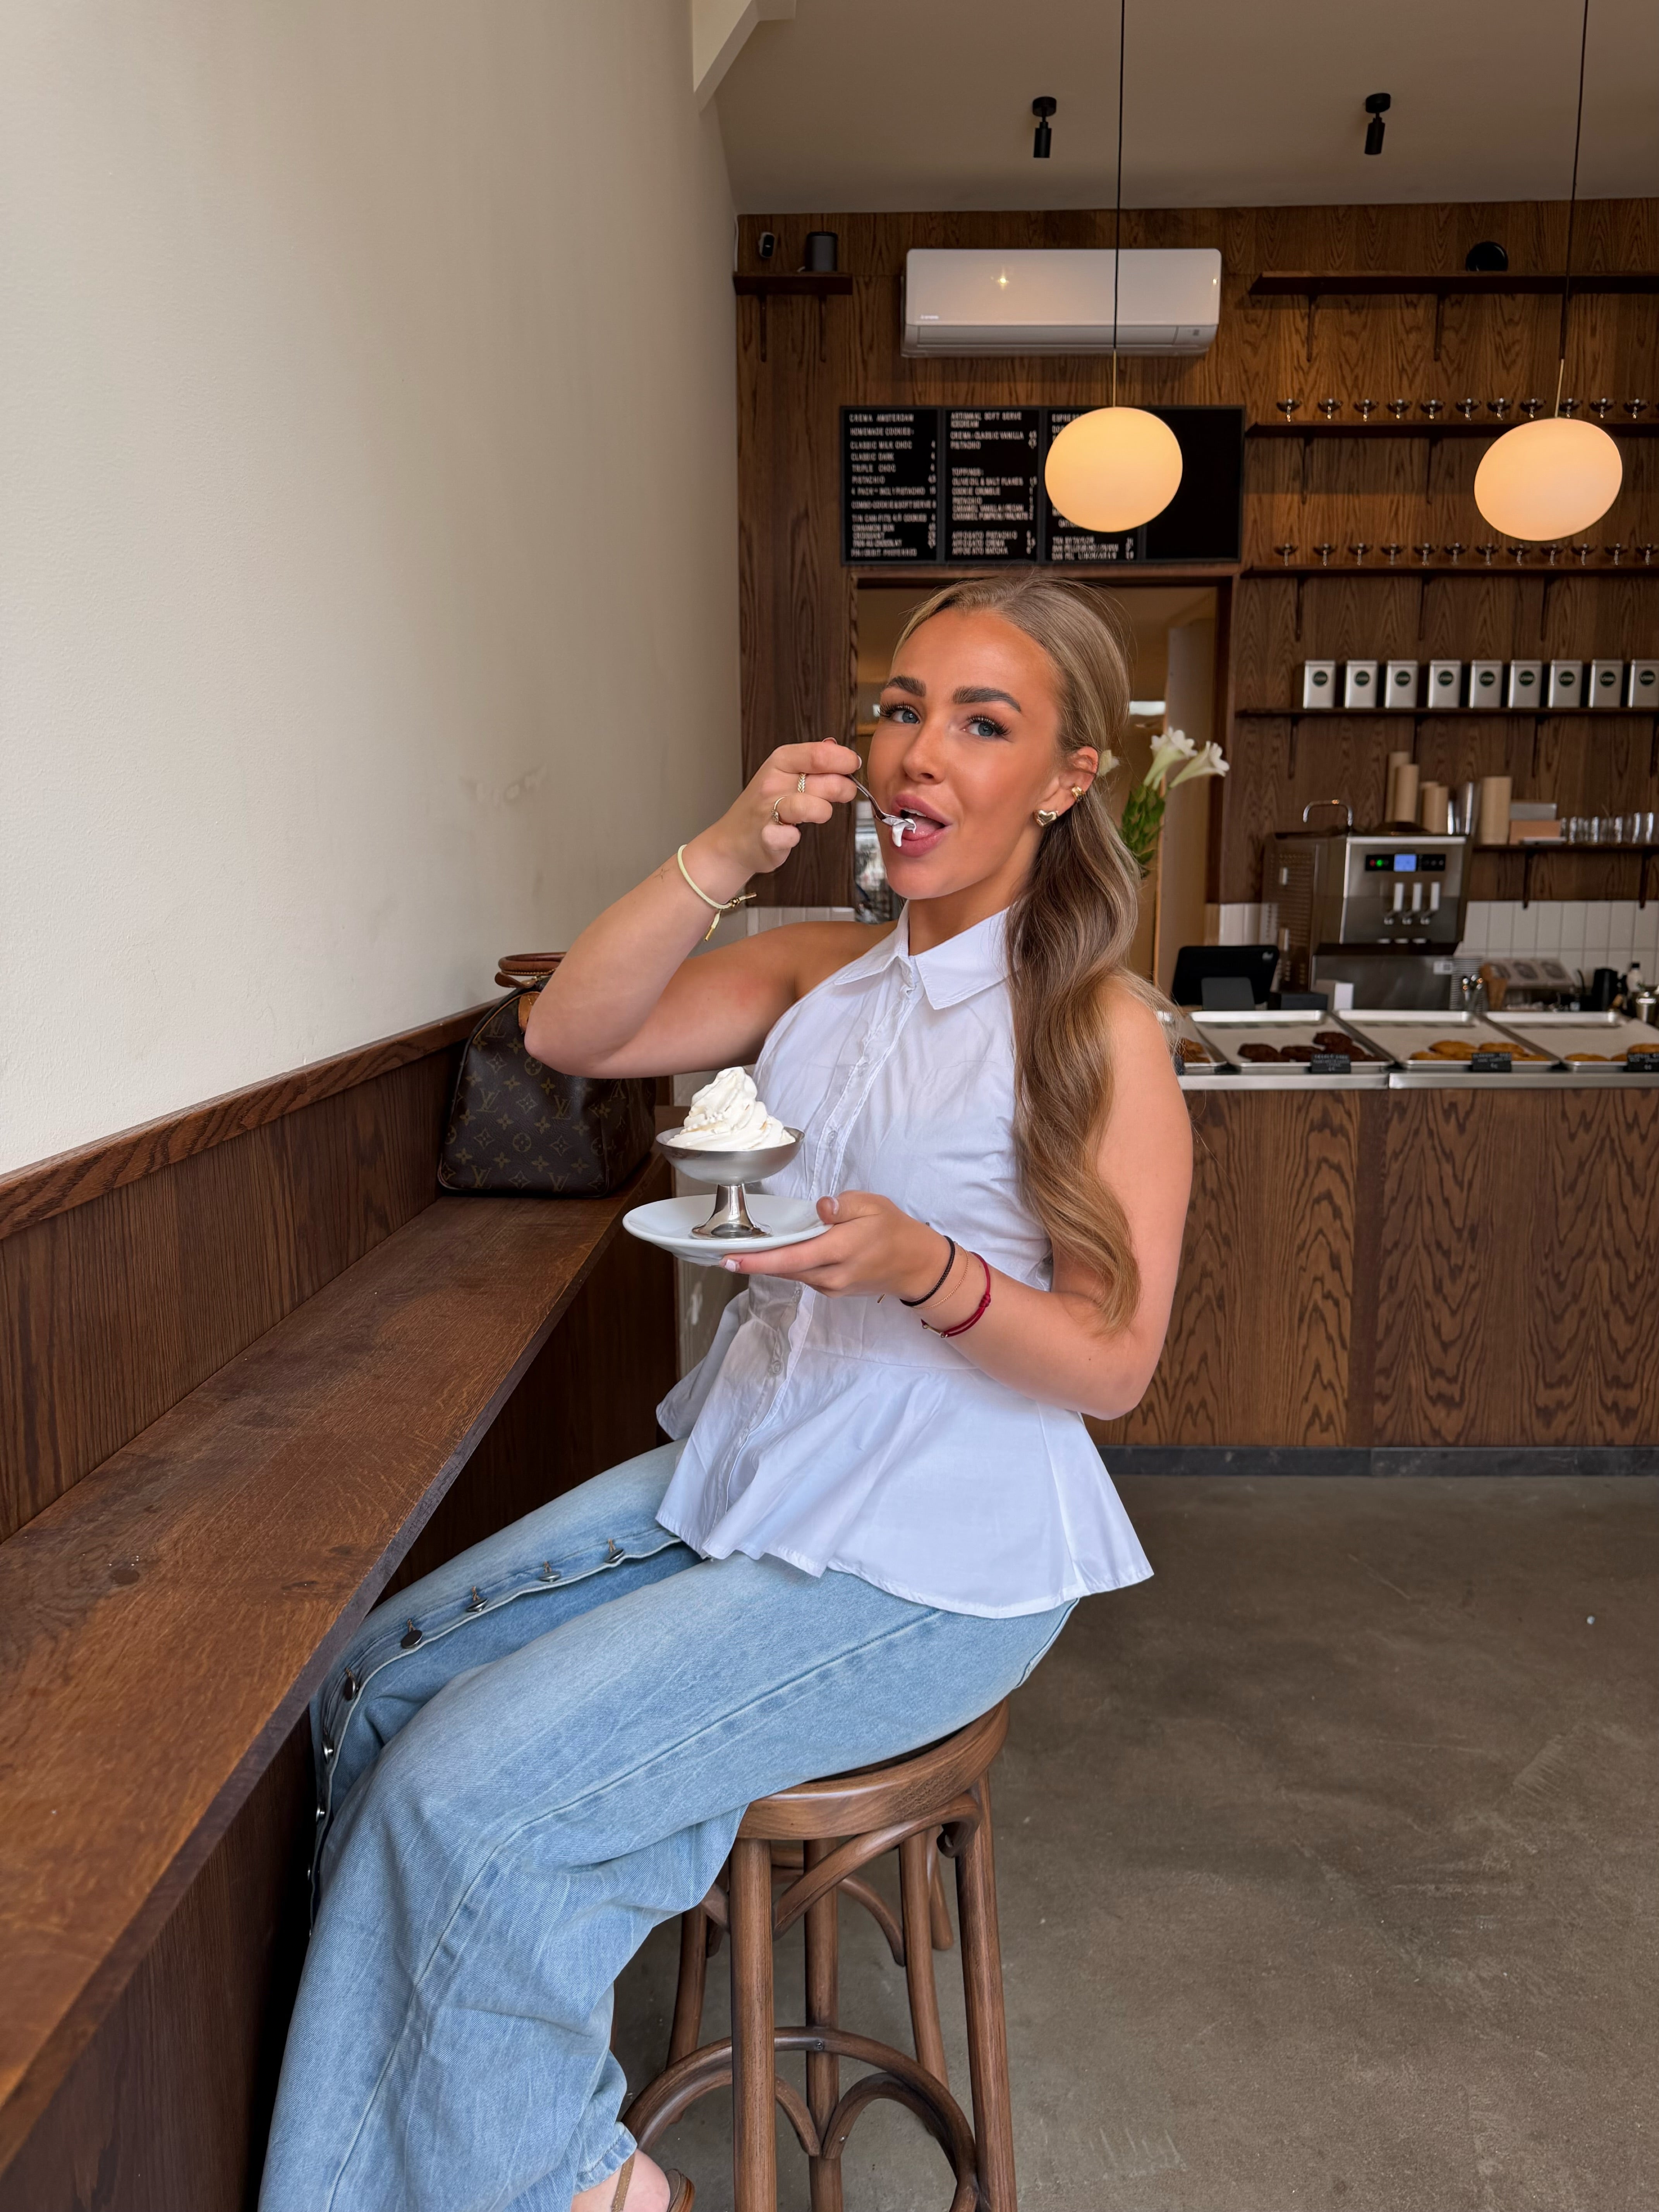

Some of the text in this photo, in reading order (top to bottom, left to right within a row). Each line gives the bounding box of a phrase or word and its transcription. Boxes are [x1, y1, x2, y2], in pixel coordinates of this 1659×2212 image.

[849, 413, 914, 422] CREMA AMSTERDAM
[951, 411, 1022, 420] ARTISANAL SOFT SERVE
[850, 427, 884, 436] HOMEMADE
[1000, 431, 1024, 440] VANILLA
[850, 441, 877, 450] CLASSIC
[879, 441, 894, 449] MILK
[895, 440, 912, 449] CHOC
[950, 440, 981, 450] PISTACHIO
[851, 452, 876, 461] CLASSIC
[878, 452, 894, 461] DARK
[852, 464, 873, 472] TRIPLE
[878, 464, 896, 472] CHOC
[852, 475, 885, 484] PISTACHIO
[896, 486, 925, 496] PISTACHIO
[952, 486, 974, 495] COOKIE
[975, 486, 1001, 495] CRUMBLE
[952, 496, 982, 504] PISTACHIO
[952, 504, 978, 513] CARAMEL
[903, 513, 927, 522] COOKIES
[952, 512, 978, 521] CARAMEL
[852, 524, 881, 532] CINNAMON
[882, 524, 895, 532] BUN
[952, 531, 984, 539] AFFOGATO
[986, 530, 1017, 539] PISTACHIO
[952, 547, 984, 555] AFFOGATO
